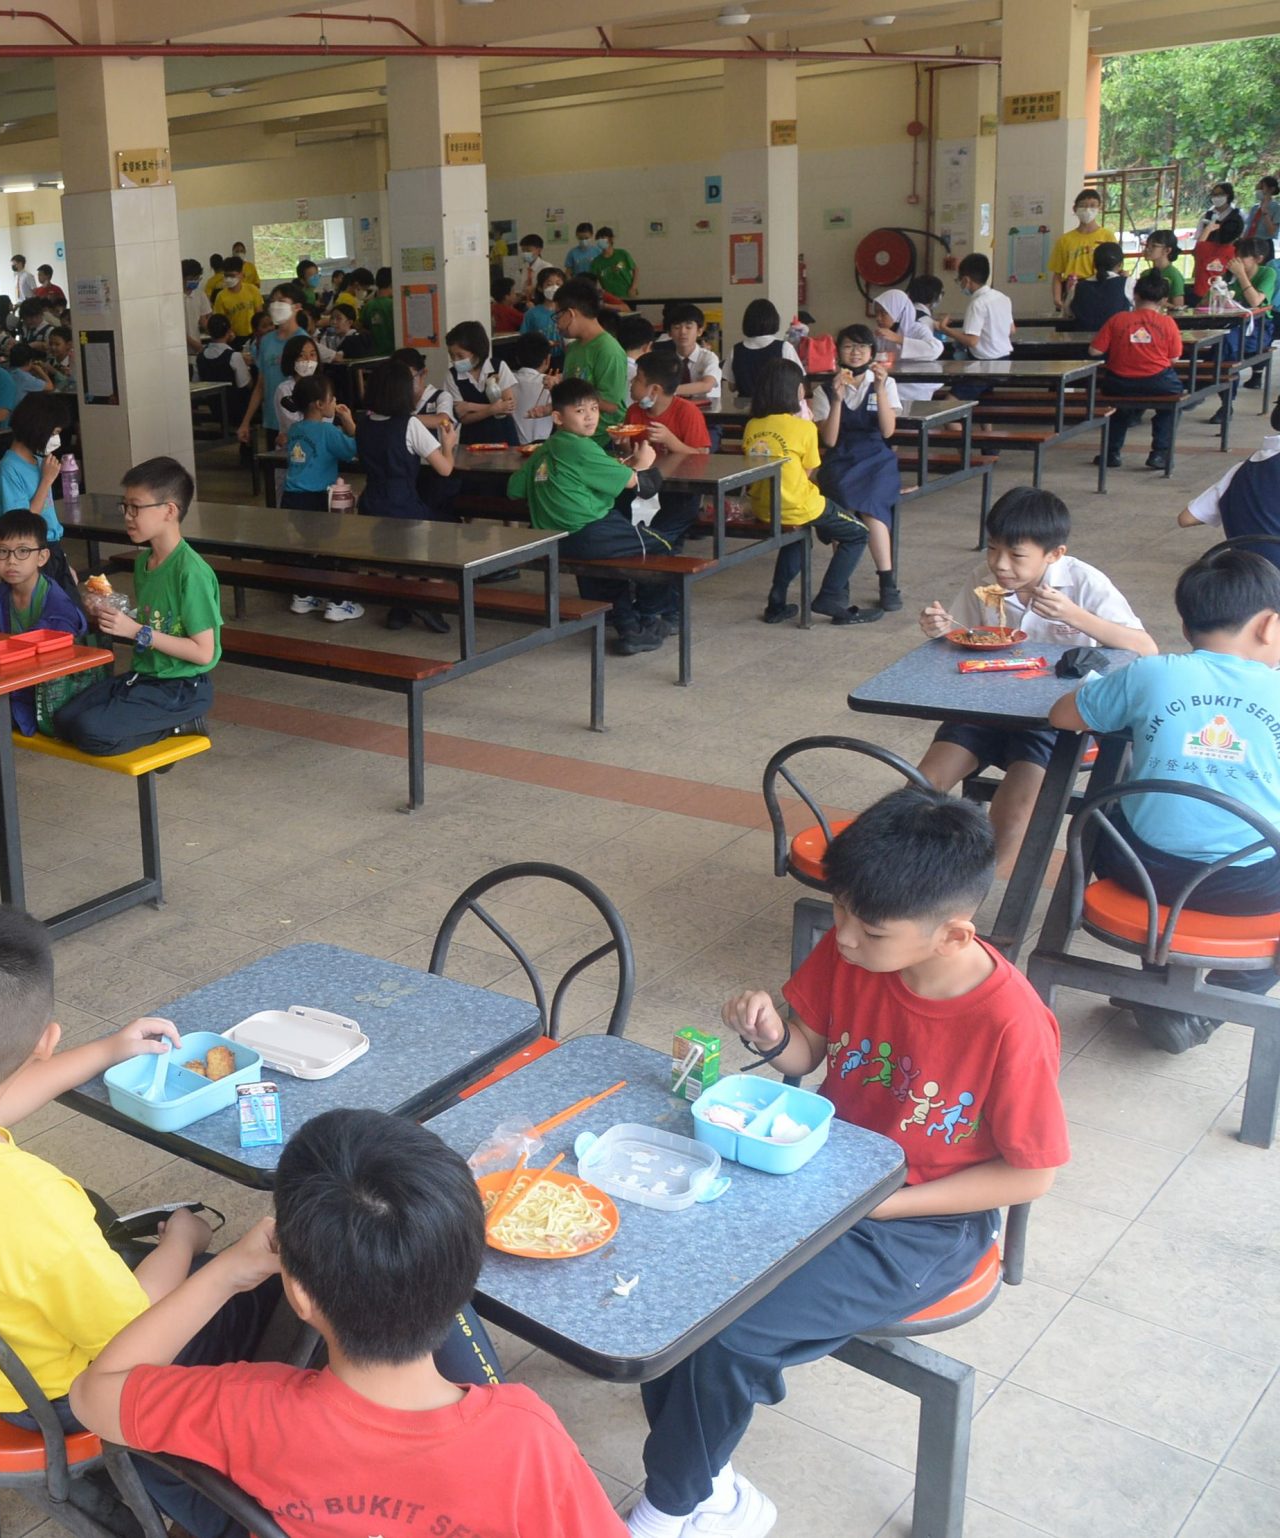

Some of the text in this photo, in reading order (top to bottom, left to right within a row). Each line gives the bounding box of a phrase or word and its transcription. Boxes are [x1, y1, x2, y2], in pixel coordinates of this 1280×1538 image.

[708, 185, 720, 199] D
[57, 248, 63, 257] C
[1145, 714, 1164, 743] SJK
[1165, 698, 1187, 717] (C)
[1191, 694, 1243, 709] BUKIT
[324, 1495, 424, 1525] BUKIT
[430, 1514, 482, 1538] SE
